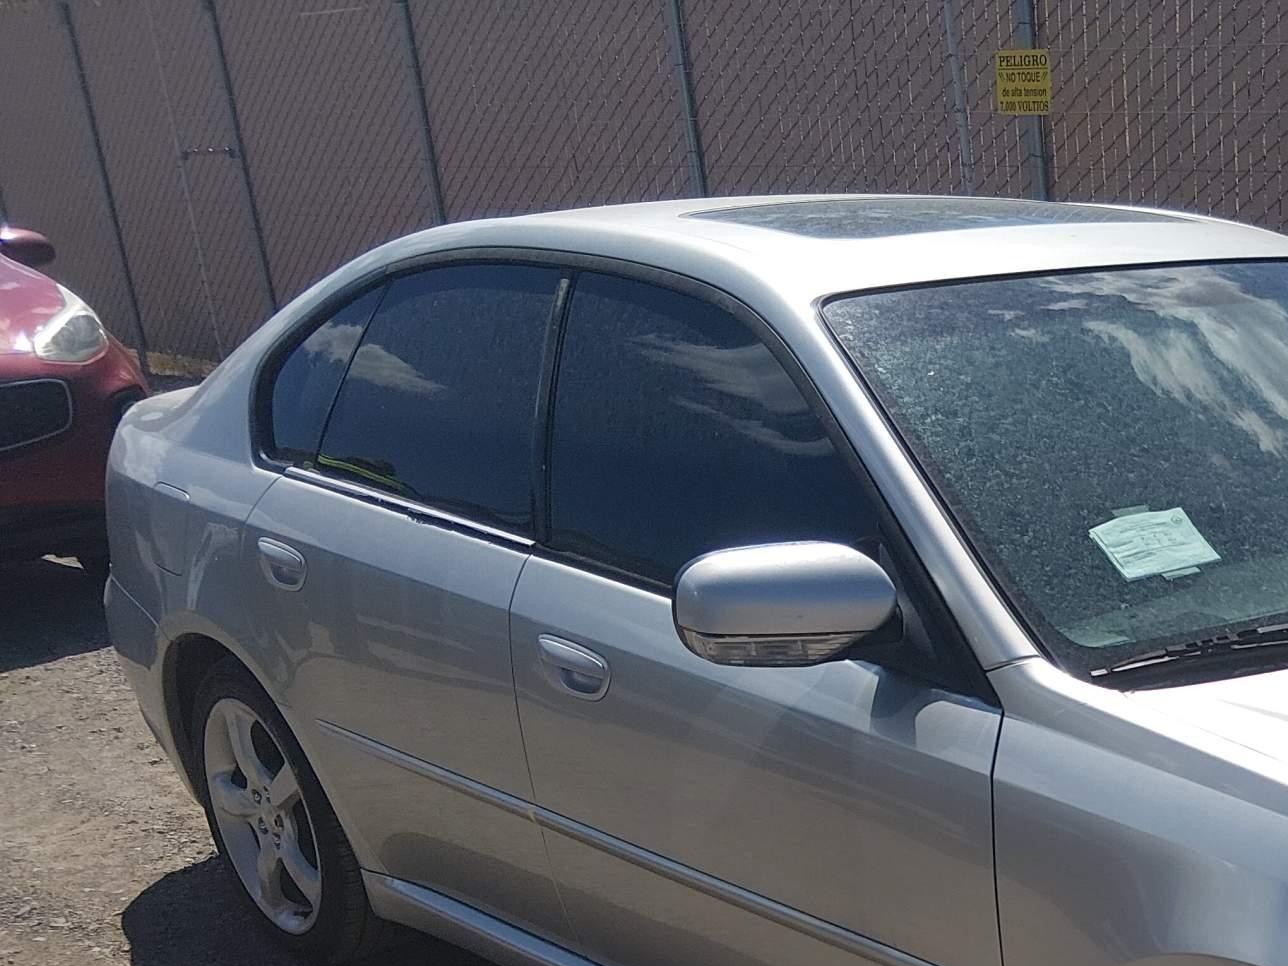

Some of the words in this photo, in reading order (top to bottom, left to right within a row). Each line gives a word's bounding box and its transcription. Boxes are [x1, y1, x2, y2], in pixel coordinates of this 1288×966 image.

[999, 54, 1047, 67] PELIGRO
[1006, 71, 1016, 83] NO
[1017, 71, 1040, 82] TOQUE
[1002, 87, 1010, 97] de
[1011, 86, 1022, 97] alta
[1017, 100, 1049, 112] VOLTIOS
